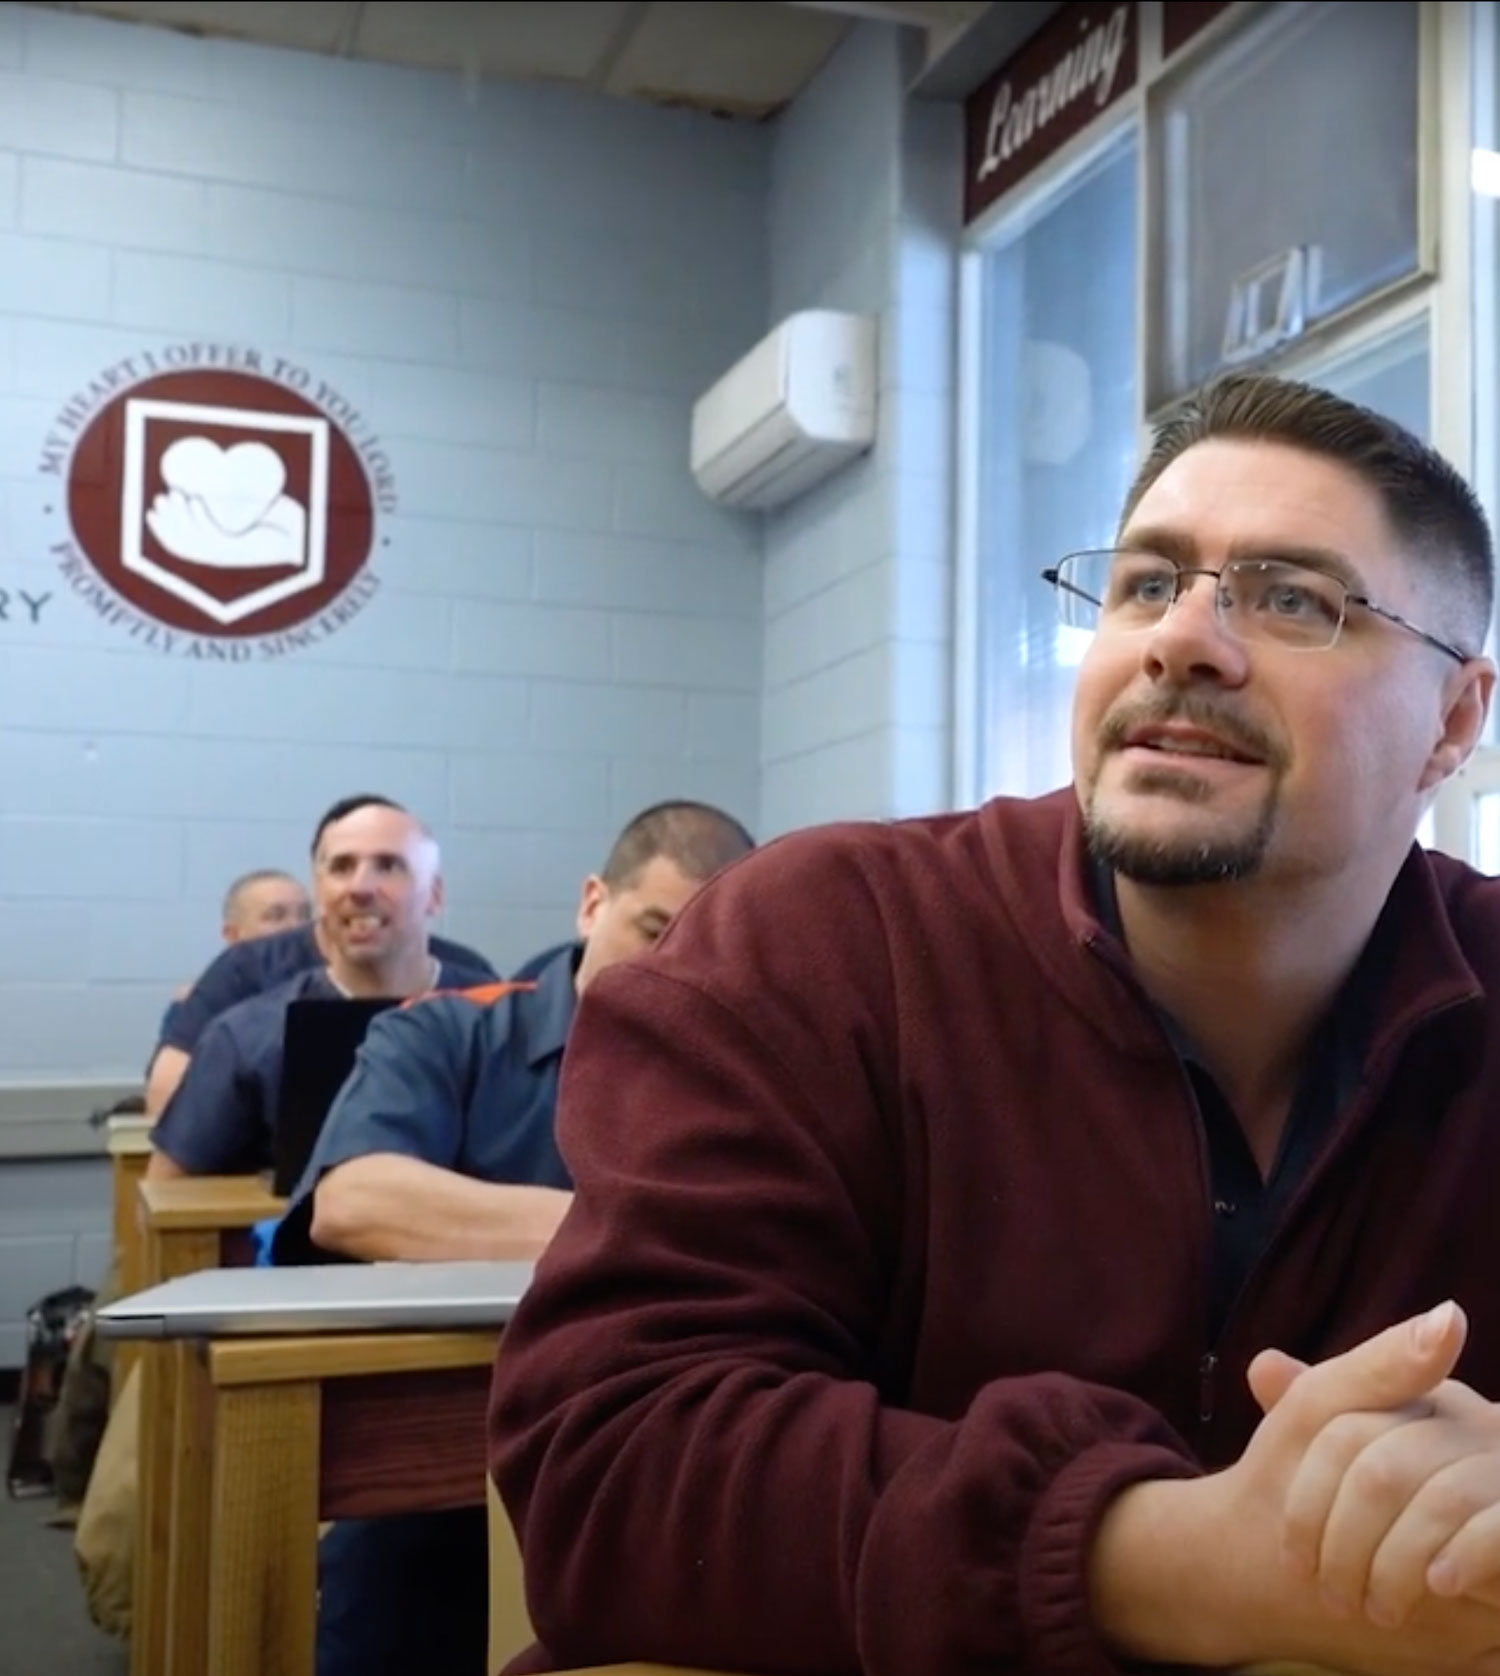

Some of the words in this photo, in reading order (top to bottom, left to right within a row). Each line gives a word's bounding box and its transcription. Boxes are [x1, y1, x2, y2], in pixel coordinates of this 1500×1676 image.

[977, 6, 1129, 183] Learning
[38, 432, 69, 476] MY
[55, 358, 138, 431] HEART
[142, 350, 158, 370] I
[162, 342, 262, 369] OFFER
[272, 356, 311, 389] TO
[315, 380, 368, 435] YOU
[358, 435, 397, 514] LORD
[50, 541, 176, 653] PROMPTLY
[184, 638, 251, 661] AND
[259, 570, 381, 657] SINCERELY
